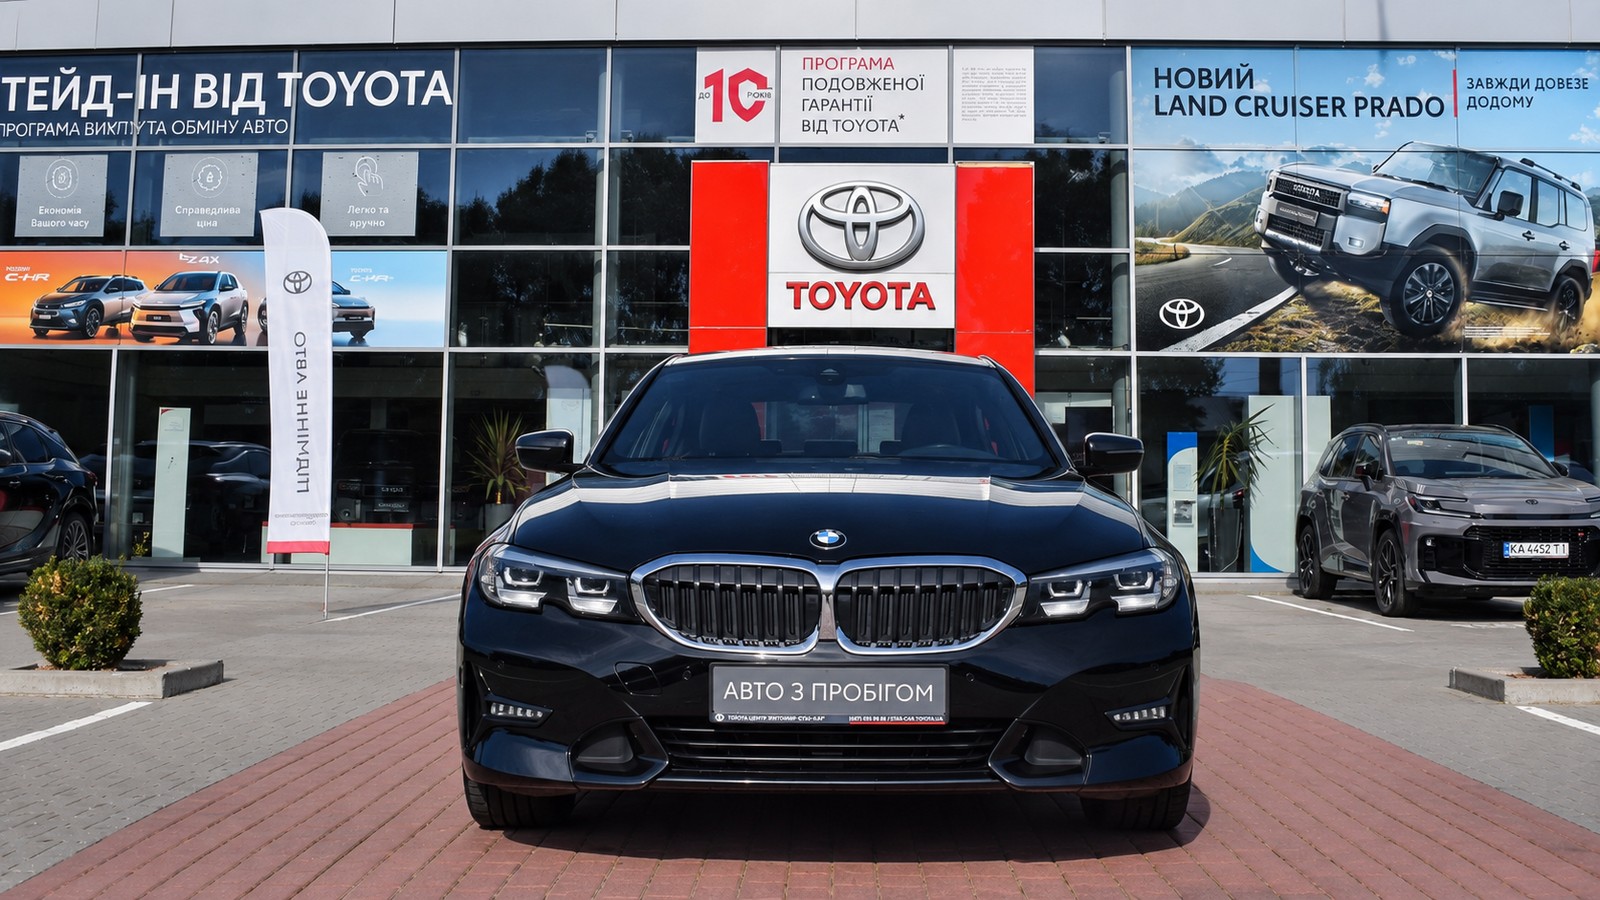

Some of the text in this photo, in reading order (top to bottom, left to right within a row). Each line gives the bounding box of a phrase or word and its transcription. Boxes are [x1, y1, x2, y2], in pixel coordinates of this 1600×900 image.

[802, 57, 895, 71] ПРОГРАМА
[802, 74, 925, 92] ПОДОВЖЕНОЇ
[1153, 63, 1254, 90] НОВИЙ
[2, 66, 453, 117] ТЕЙД-ІН ВІД TOYOTA
[1466, 77, 1589, 92] ЗАВЖДИ ДОВЕЗЕ
[698, 92, 711, 100] ДО
[746, 91, 772, 99] РОКІВ
[1466, 95, 1534, 110] ДОДОМУ
[802, 96, 873, 112] ГАРАНТІЇ
[1154, 95, 1445, 118] LAND CRUISER PRADO
[149, 120, 168, 135] ТА
[171, 119, 239, 135] ОБМІНУ
[242, 119, 289, 134] АВТО
[802, 118, 828, 134] ВІД
[38, 205, 82, 215] Економія
[175, 205, 241, 216] Справедлива
[347, 205, 389, 214] Легко та
[31, 218, 90, 230] Вашого часу
[4, 273, 51, 281] C-HR
[786, 281, 936, 311] TOYOTA
[1510, 544, 1525, 554] KA
[723, 681, 784, 700] АВТО
[812, 683, 933, 702] ПРОБІГОМ
